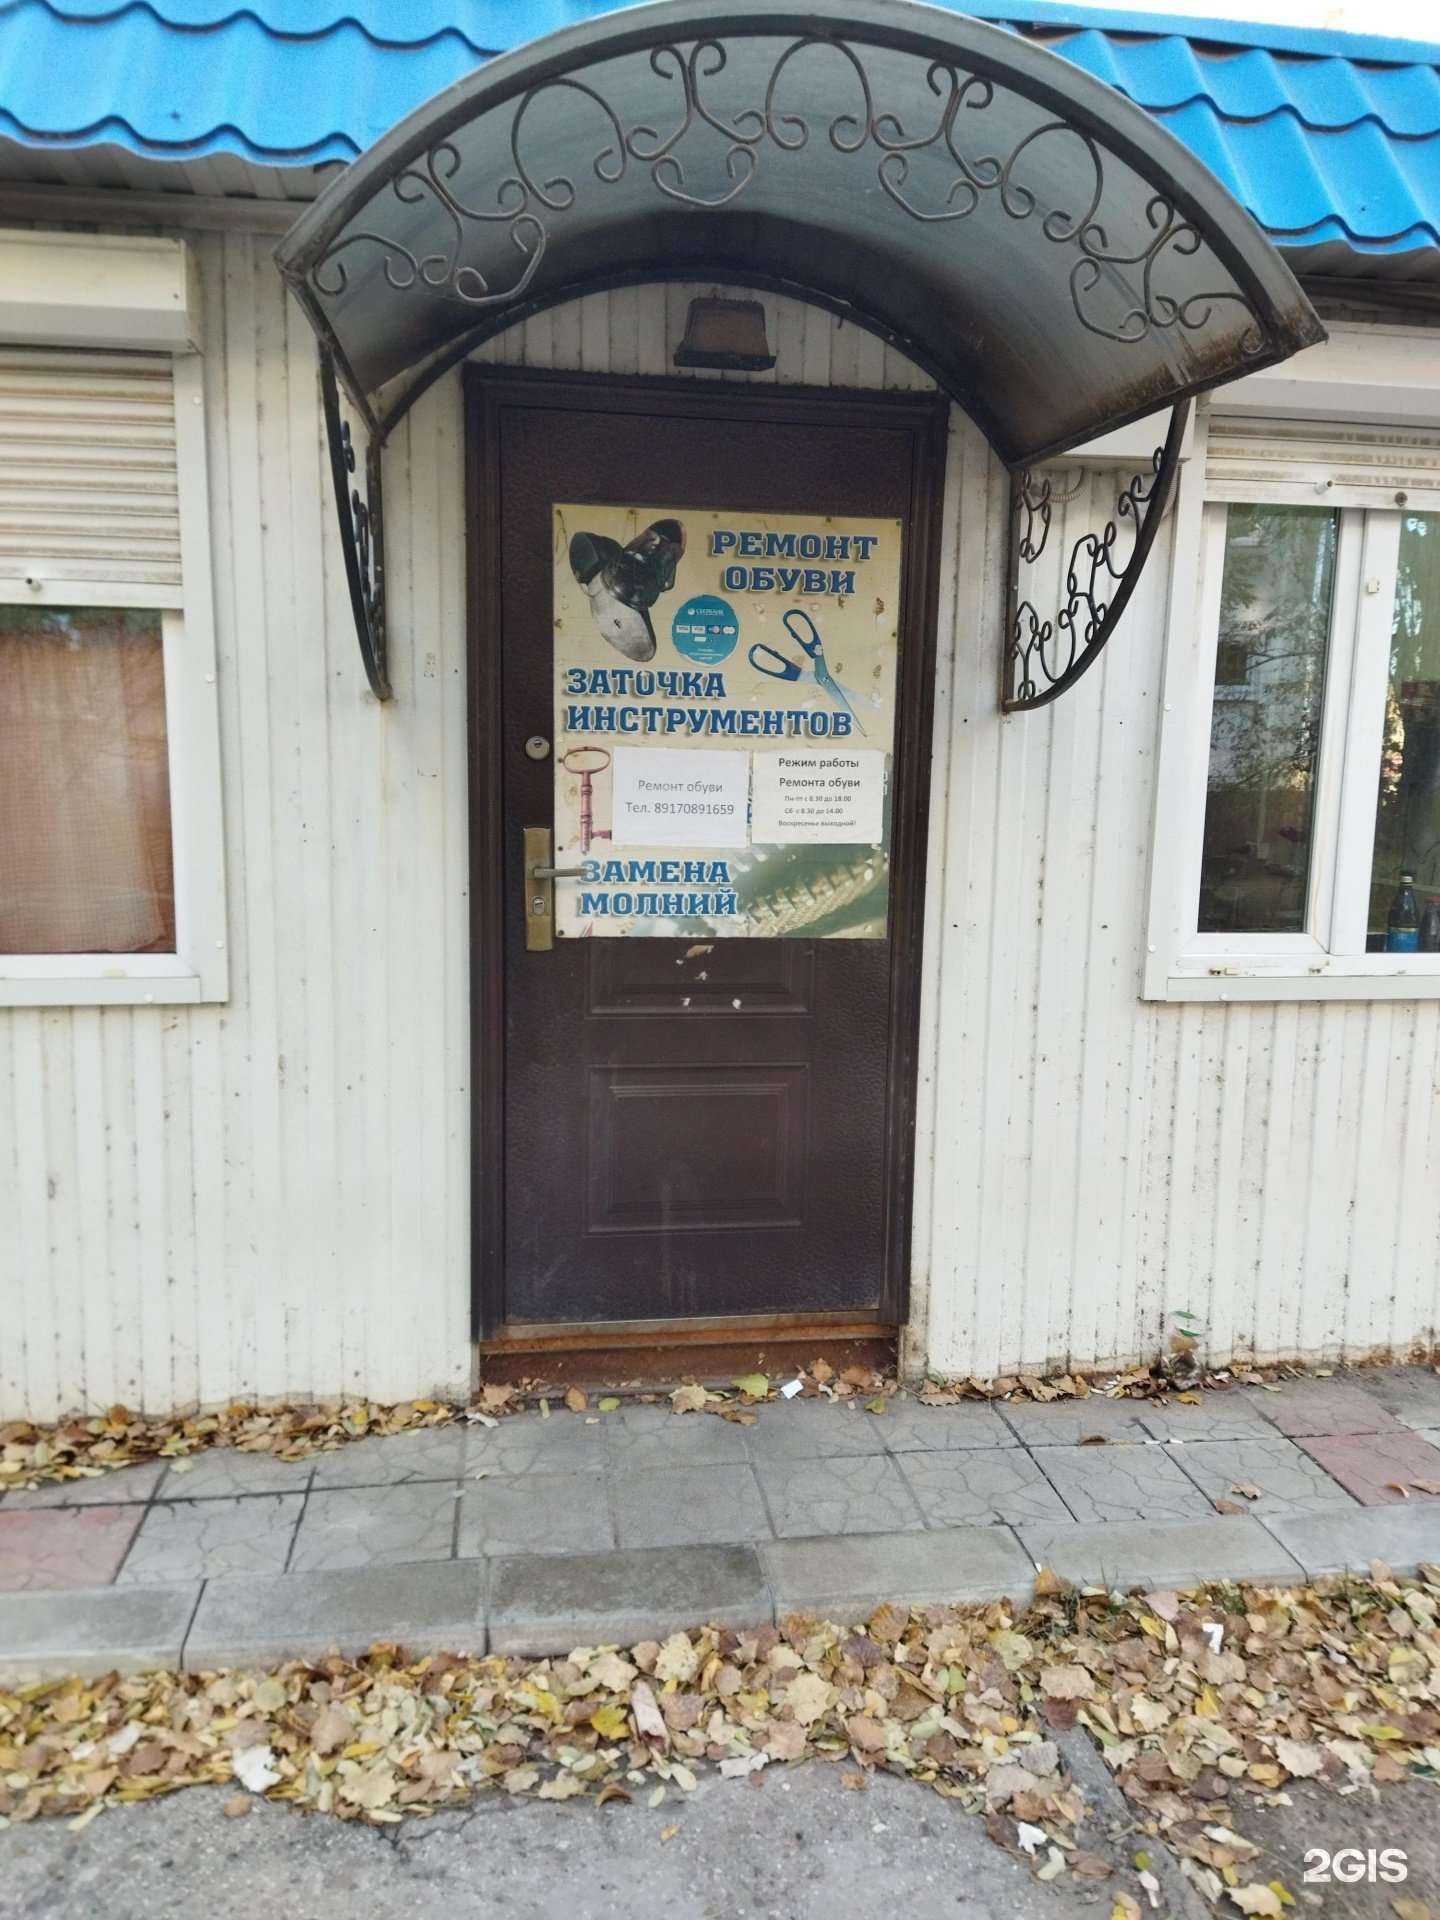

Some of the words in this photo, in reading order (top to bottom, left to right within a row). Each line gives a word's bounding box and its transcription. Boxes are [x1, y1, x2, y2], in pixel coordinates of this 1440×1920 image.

[712, 530, 879, 561] РЕМОНТ
[725, 566, 856, 594] ОБУВИ
[566, 668, 727, 697] ЗАТОЧКА
[567, 705, 852, 738] ИНСТРУМЕНТОВ
[779, 758, 816, 767] Режим
[820, 758, 859, 769] работы
[639, 780, 683, 791] Ремонт
[687, 781, 723, 793] обуви
[780, 777, 825, 787] Ремонта
[829, 777, 860, 789] обуви
[626, 802, 651, 812] Тел.
[655, 803, 734, 814] 89170891659
[580, 860, 730, 883] ЗАМЕНА
[580, 888, 737, 915] МОЛНИЙ
